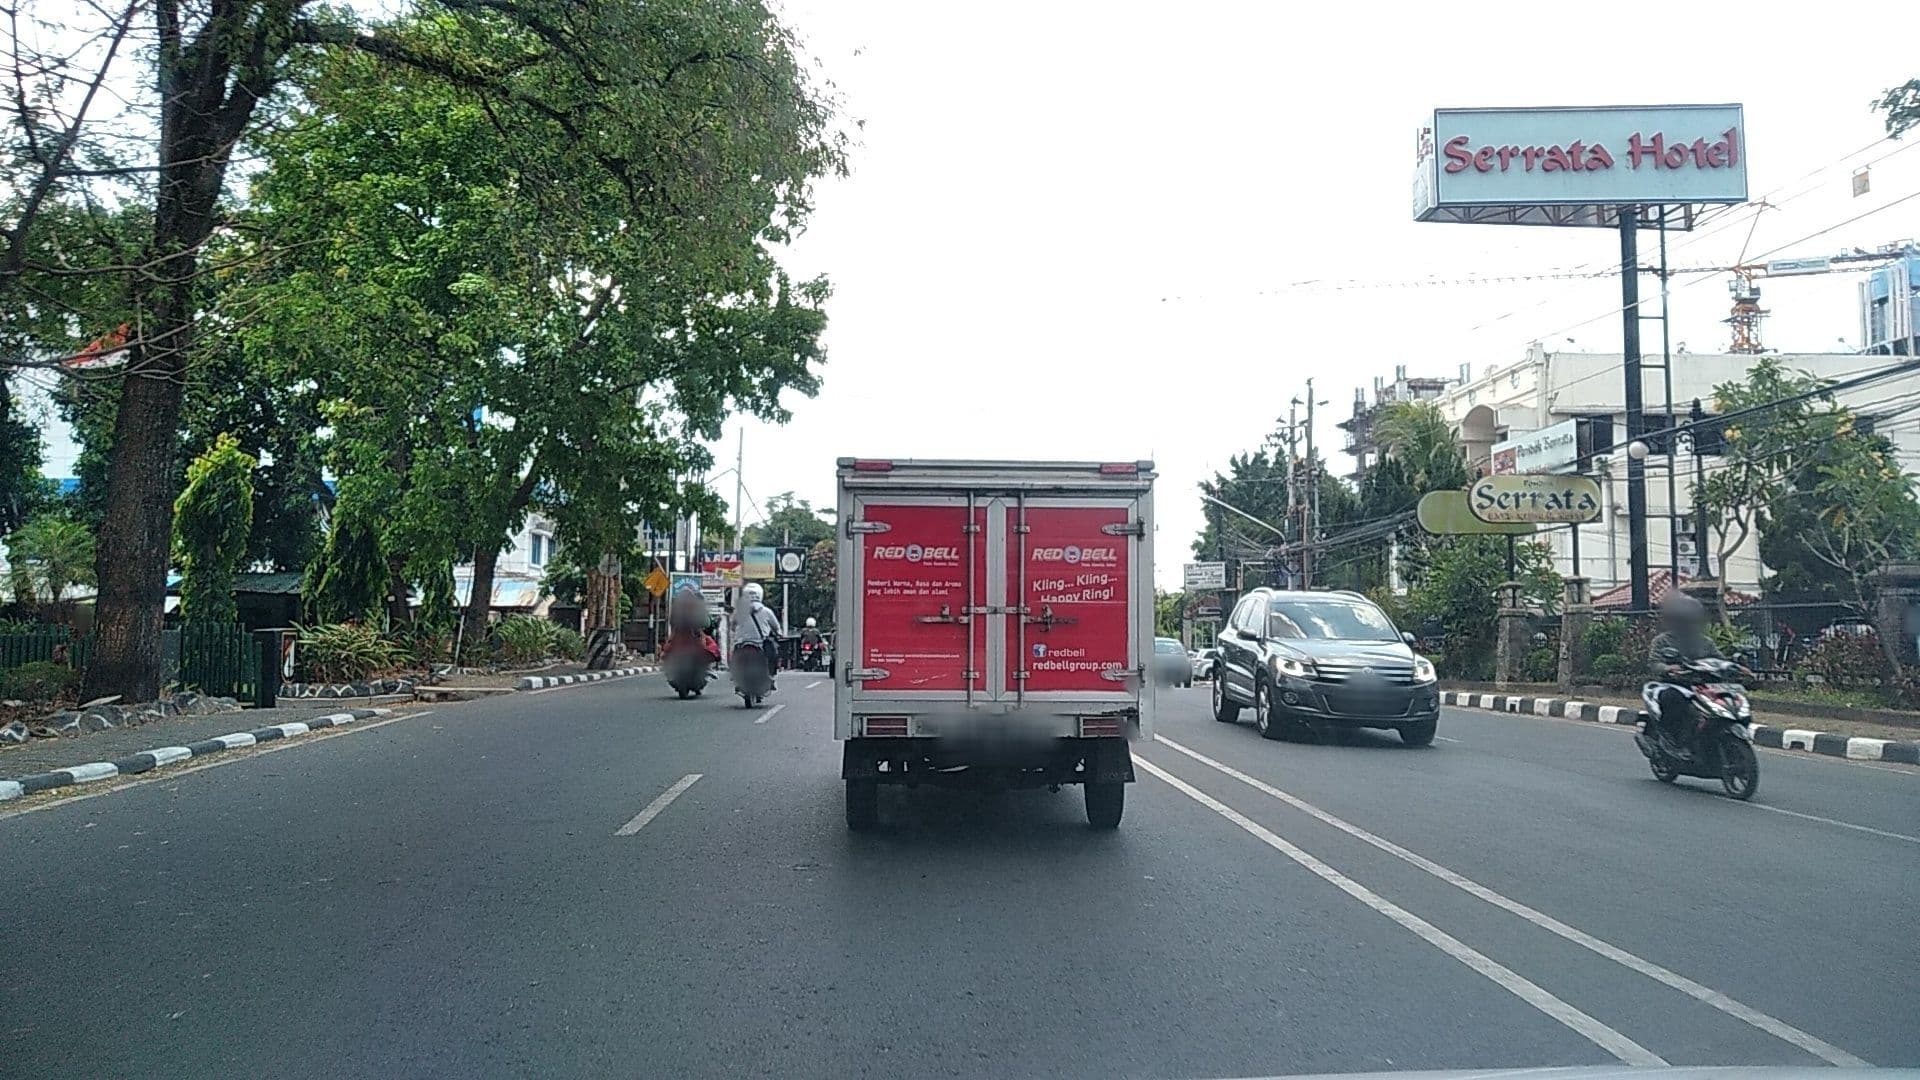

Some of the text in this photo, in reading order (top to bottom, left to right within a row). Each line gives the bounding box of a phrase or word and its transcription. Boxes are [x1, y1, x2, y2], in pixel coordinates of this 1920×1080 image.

[1443, 135, 1615, 174] Serrata
[1627, 126, 1737, 171] Hotel
[1476, 484, 1597, 511] Serrata
[873, 546, 960, 560] RED BELL
[1032, 548, 1118, 561] RED BELL
[1082, 586, 1114, 600] Ring!
[1048, 648, 1085, 657] redbell
[1032, 660, 1122, 672] redbellgroup.com
